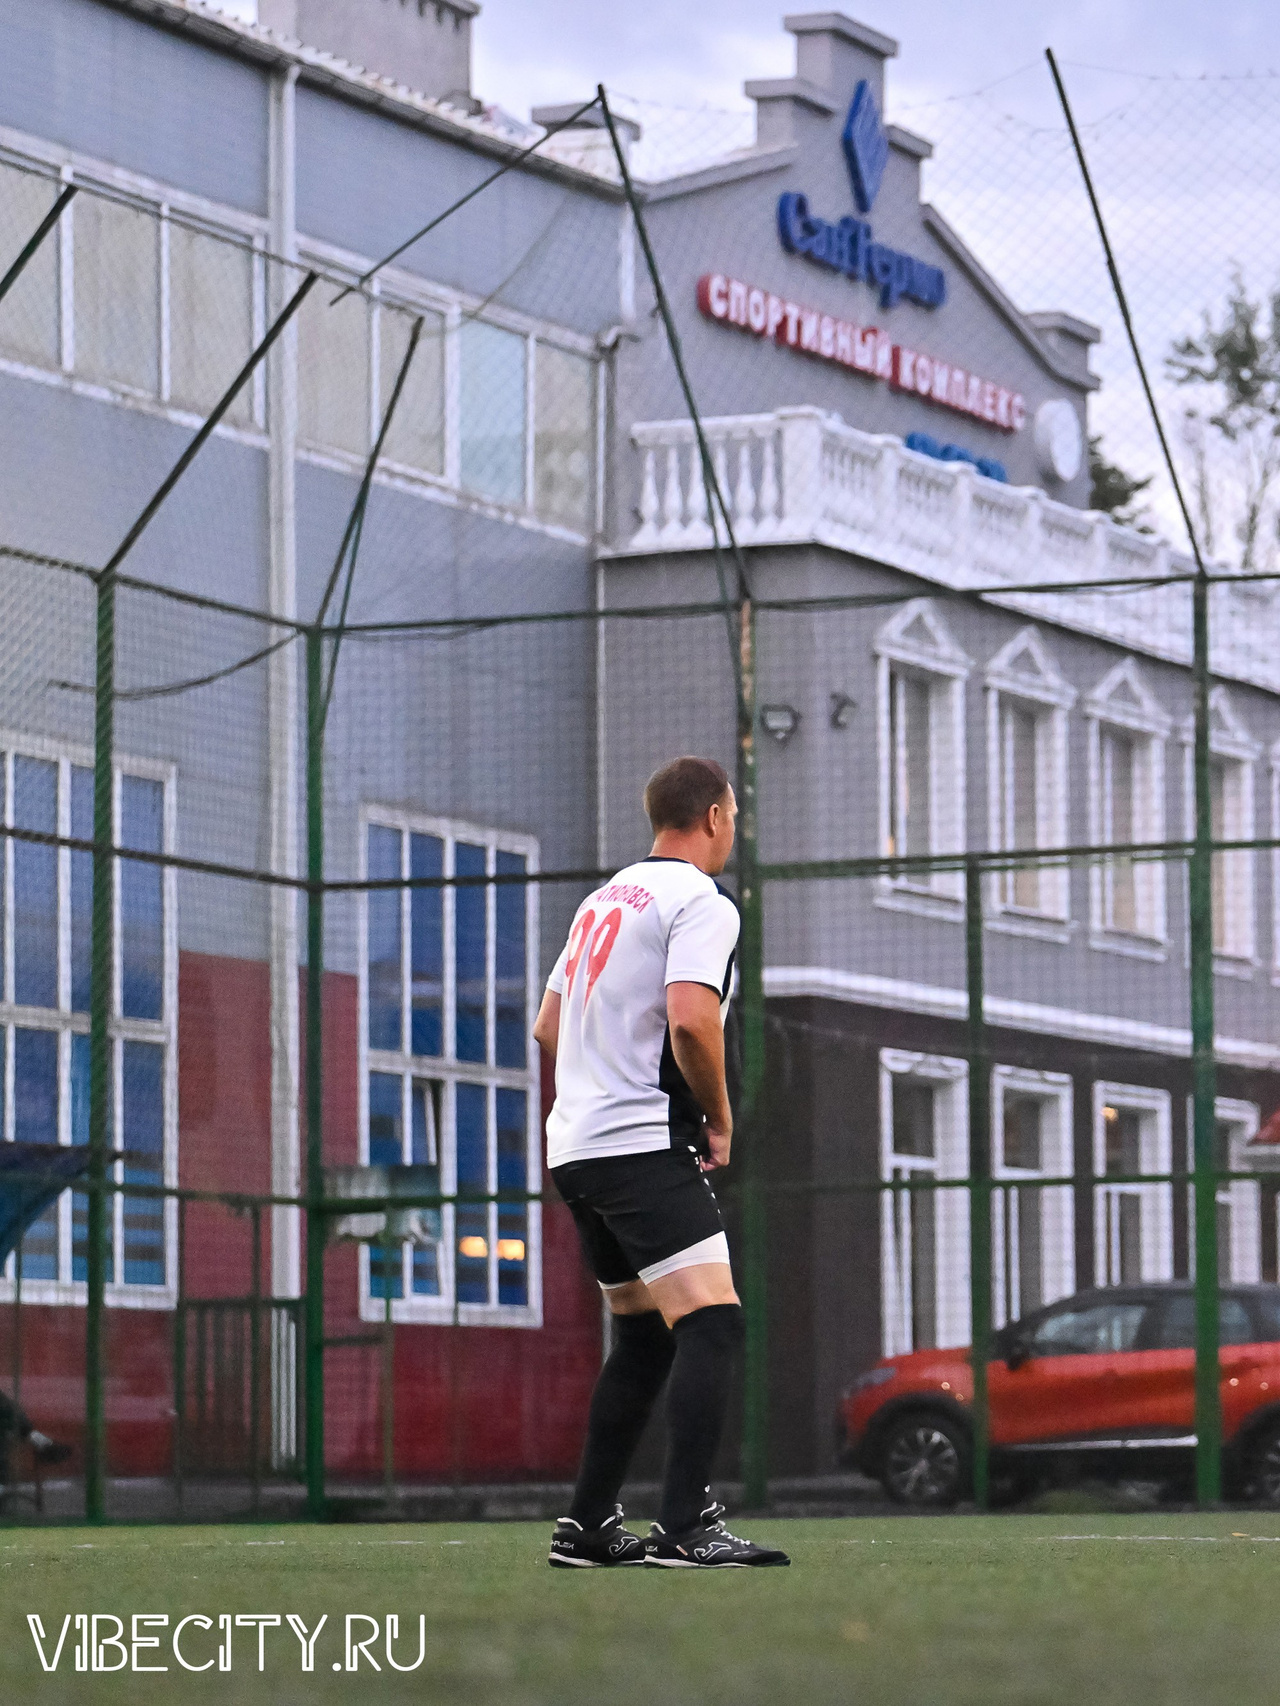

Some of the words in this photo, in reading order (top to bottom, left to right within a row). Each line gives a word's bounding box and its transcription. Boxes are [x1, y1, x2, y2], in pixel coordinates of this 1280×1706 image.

[702, 272, 893, 381] СПОРТИВНЫЙ
[895, 346, 1026, 434] КОМПЛЕКС
[564, 907, 622, 1017] 99
